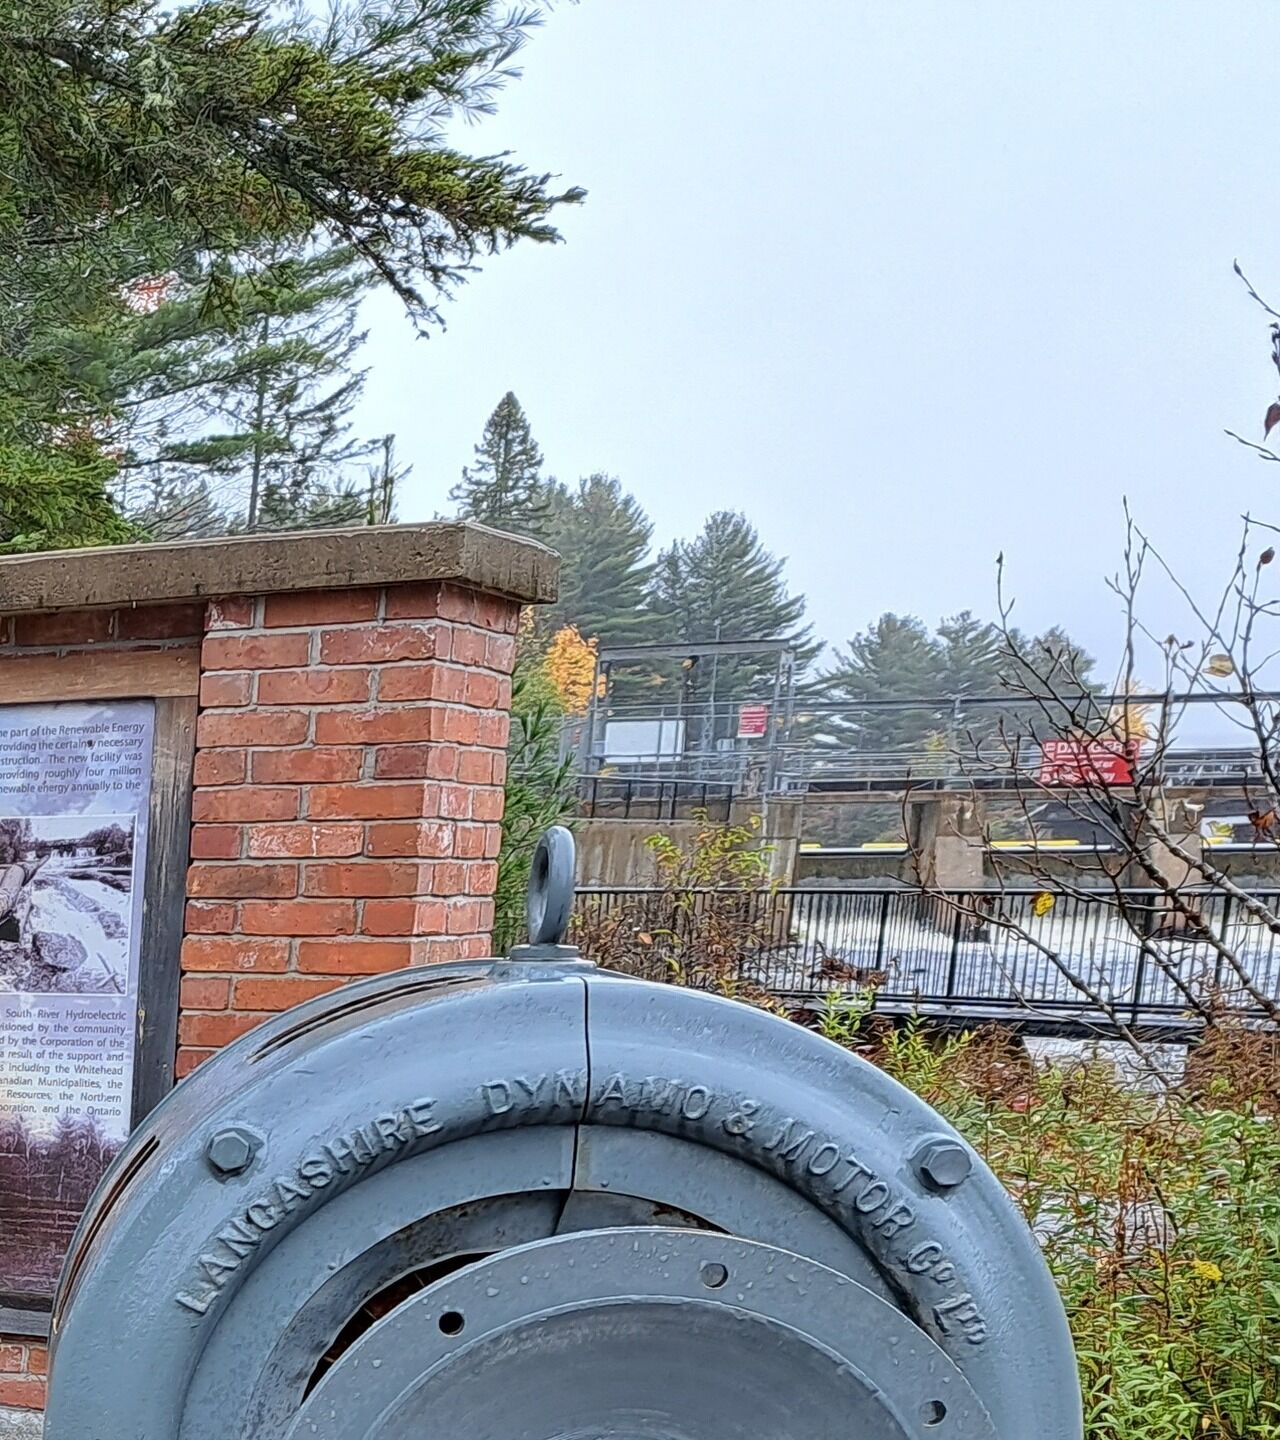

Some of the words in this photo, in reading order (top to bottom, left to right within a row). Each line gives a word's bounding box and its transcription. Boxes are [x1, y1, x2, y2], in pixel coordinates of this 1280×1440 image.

[10, 727, 29, 739] part
[30, 725, 40, 736] of
[41, 725, 57, 735] the
[58, 723, 109, 734] Renewable
[111, 721, 145, 735] Energy
[38, 739, 54, 749] the
[54, 737, 97, 751] certainy
[97, 738, 144, 750] necessary
[47, 753, 65, 763] The
[67, 754, 87, 762] new
[90, 751, 122, 764] facility
[123, 753, 143, 761] was
[44, 766, 80, 780] roughly
[85, 766, 104, 776] four
[109, 764, 141, 775] million
[37, 783, 69, 794] energy
[70, 780, 111, 793] annually
[112, 780, 123, 789] to
[125, 779, 141, 789] the
[5, 1008, 32, 1018] South
[37, 1009, 60, 1018] River
[65, 1009, 126, 1022] Hydroelectric
[37, 1022, 49, 1034] by
[53, 1022, 69, 1032] the
[73, 1023, 126, 1036] community
[7, 1035, 19, 1047] by
[21, 1035, 37, 1045] the
[39, 1036, 93, 1049] Corporation
[96, 1037, 106, 1046] of
[109, 1037, 125, 1047] the
[7, 1048, 32, 1058] result
[35, 1049, 46, 1058] of
[48, 1049, 63, 1059] the
[66, 1050, 103, 1063] support
[106, 1051, 124, 1061] and
[8, 1062, 50, 1075] including
[54, 1063, 70, 1073] the
[74, 1064, 123, 1074] Whitehead
[107, 1079, 123, 1088] the
[58, 1090, 74, 1100] the
[80, 1091, 122, 1102] Northern
[42, 1103, 59, 1113] and
[65, 1104, 81, 1114] the
[86, 1105, 121, 1115] Ontario
[175, 1097, 443, 1313] LANCASHIRE
[481, 1069, 712, 1119] DYNAMO
[721, 1100, 761, 1141] &
[763, 1118, 915, 1238] MOTOR
